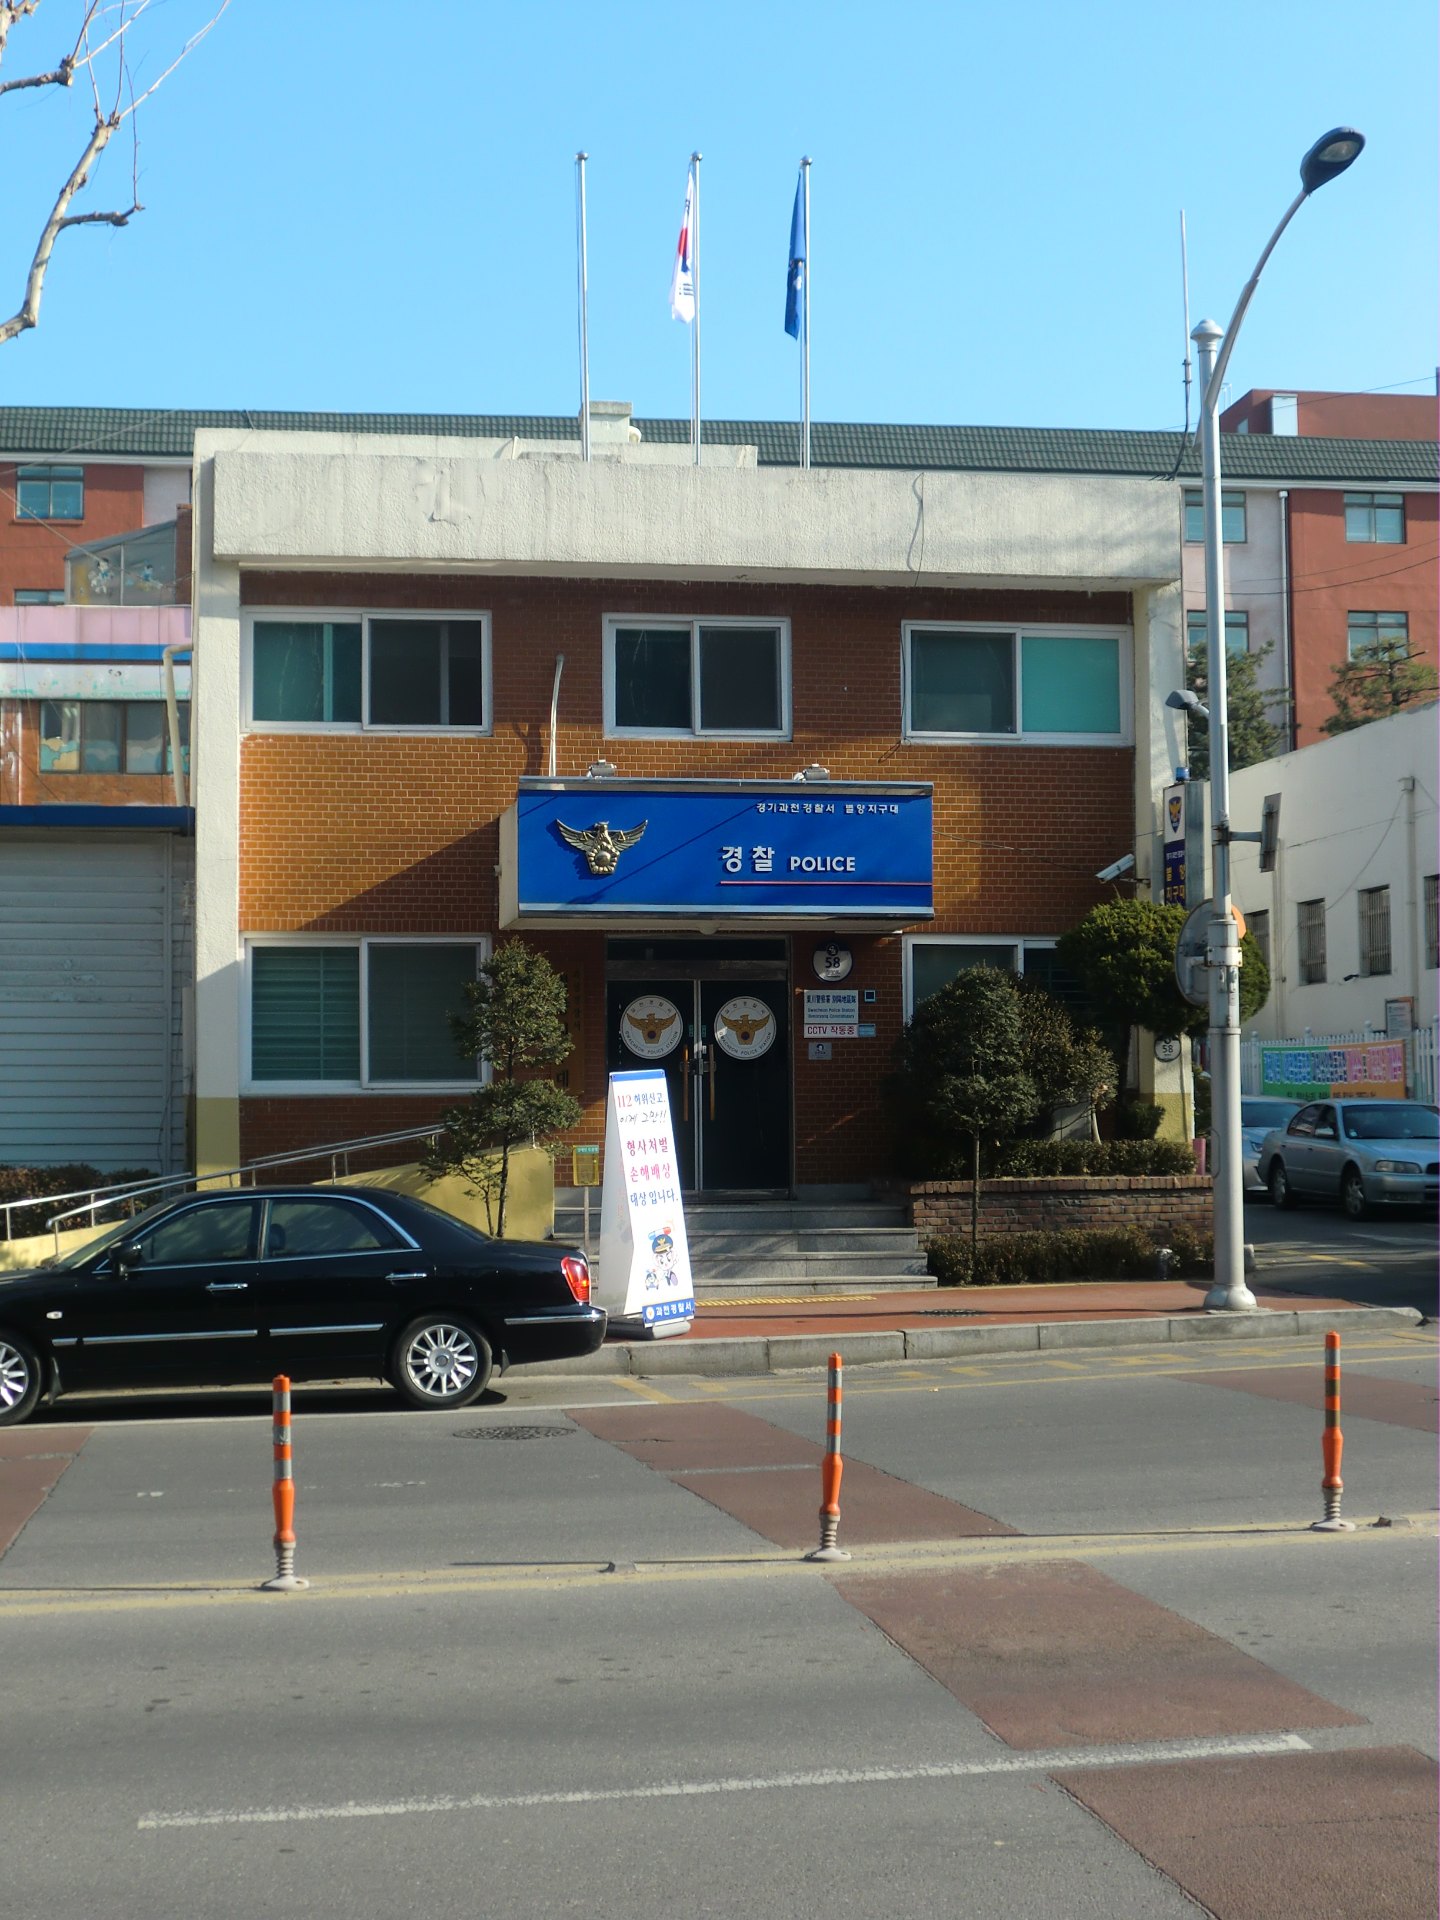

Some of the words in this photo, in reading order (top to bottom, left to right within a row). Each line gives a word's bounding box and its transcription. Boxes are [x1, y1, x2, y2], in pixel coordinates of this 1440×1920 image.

[722, 846, 775, 872] 경찰
[790, 856, 855, 871] POLICE
[825, 957, 840, 968] 58
[808, 1026, 827, 1035] CCTV
[831, 1026, 854, 1035] 작동중
[1162, 1044, 1174, 1054] 58
[617, 1094, 633, 1108] 112
[626, 1136, 668, 1156] 형사처벌
[630, 1163, 671, 1183] 손해배상
[655, 1301, 692, 1317] 과천경찰서
